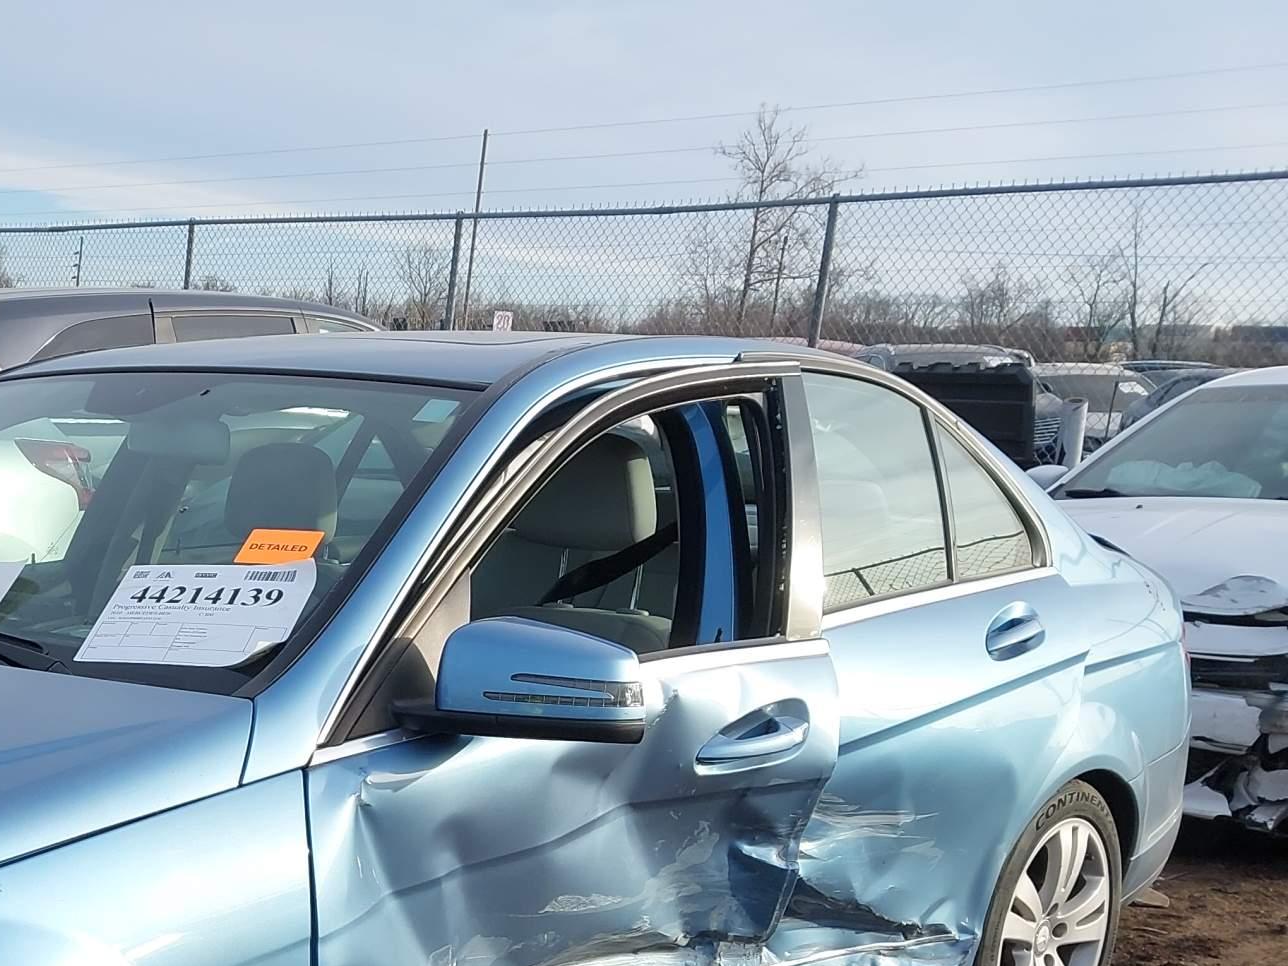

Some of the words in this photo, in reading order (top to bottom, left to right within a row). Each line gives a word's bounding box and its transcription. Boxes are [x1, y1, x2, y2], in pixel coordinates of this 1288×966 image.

[248, 542, 308, 553] DETAILED
[130, 585, 284, 607] 44214139
[113, 603, 157, 611] Progressive
[158, 604, 192, 612] Casualty
[1035, 791, 1114, 834] CONTINENT
